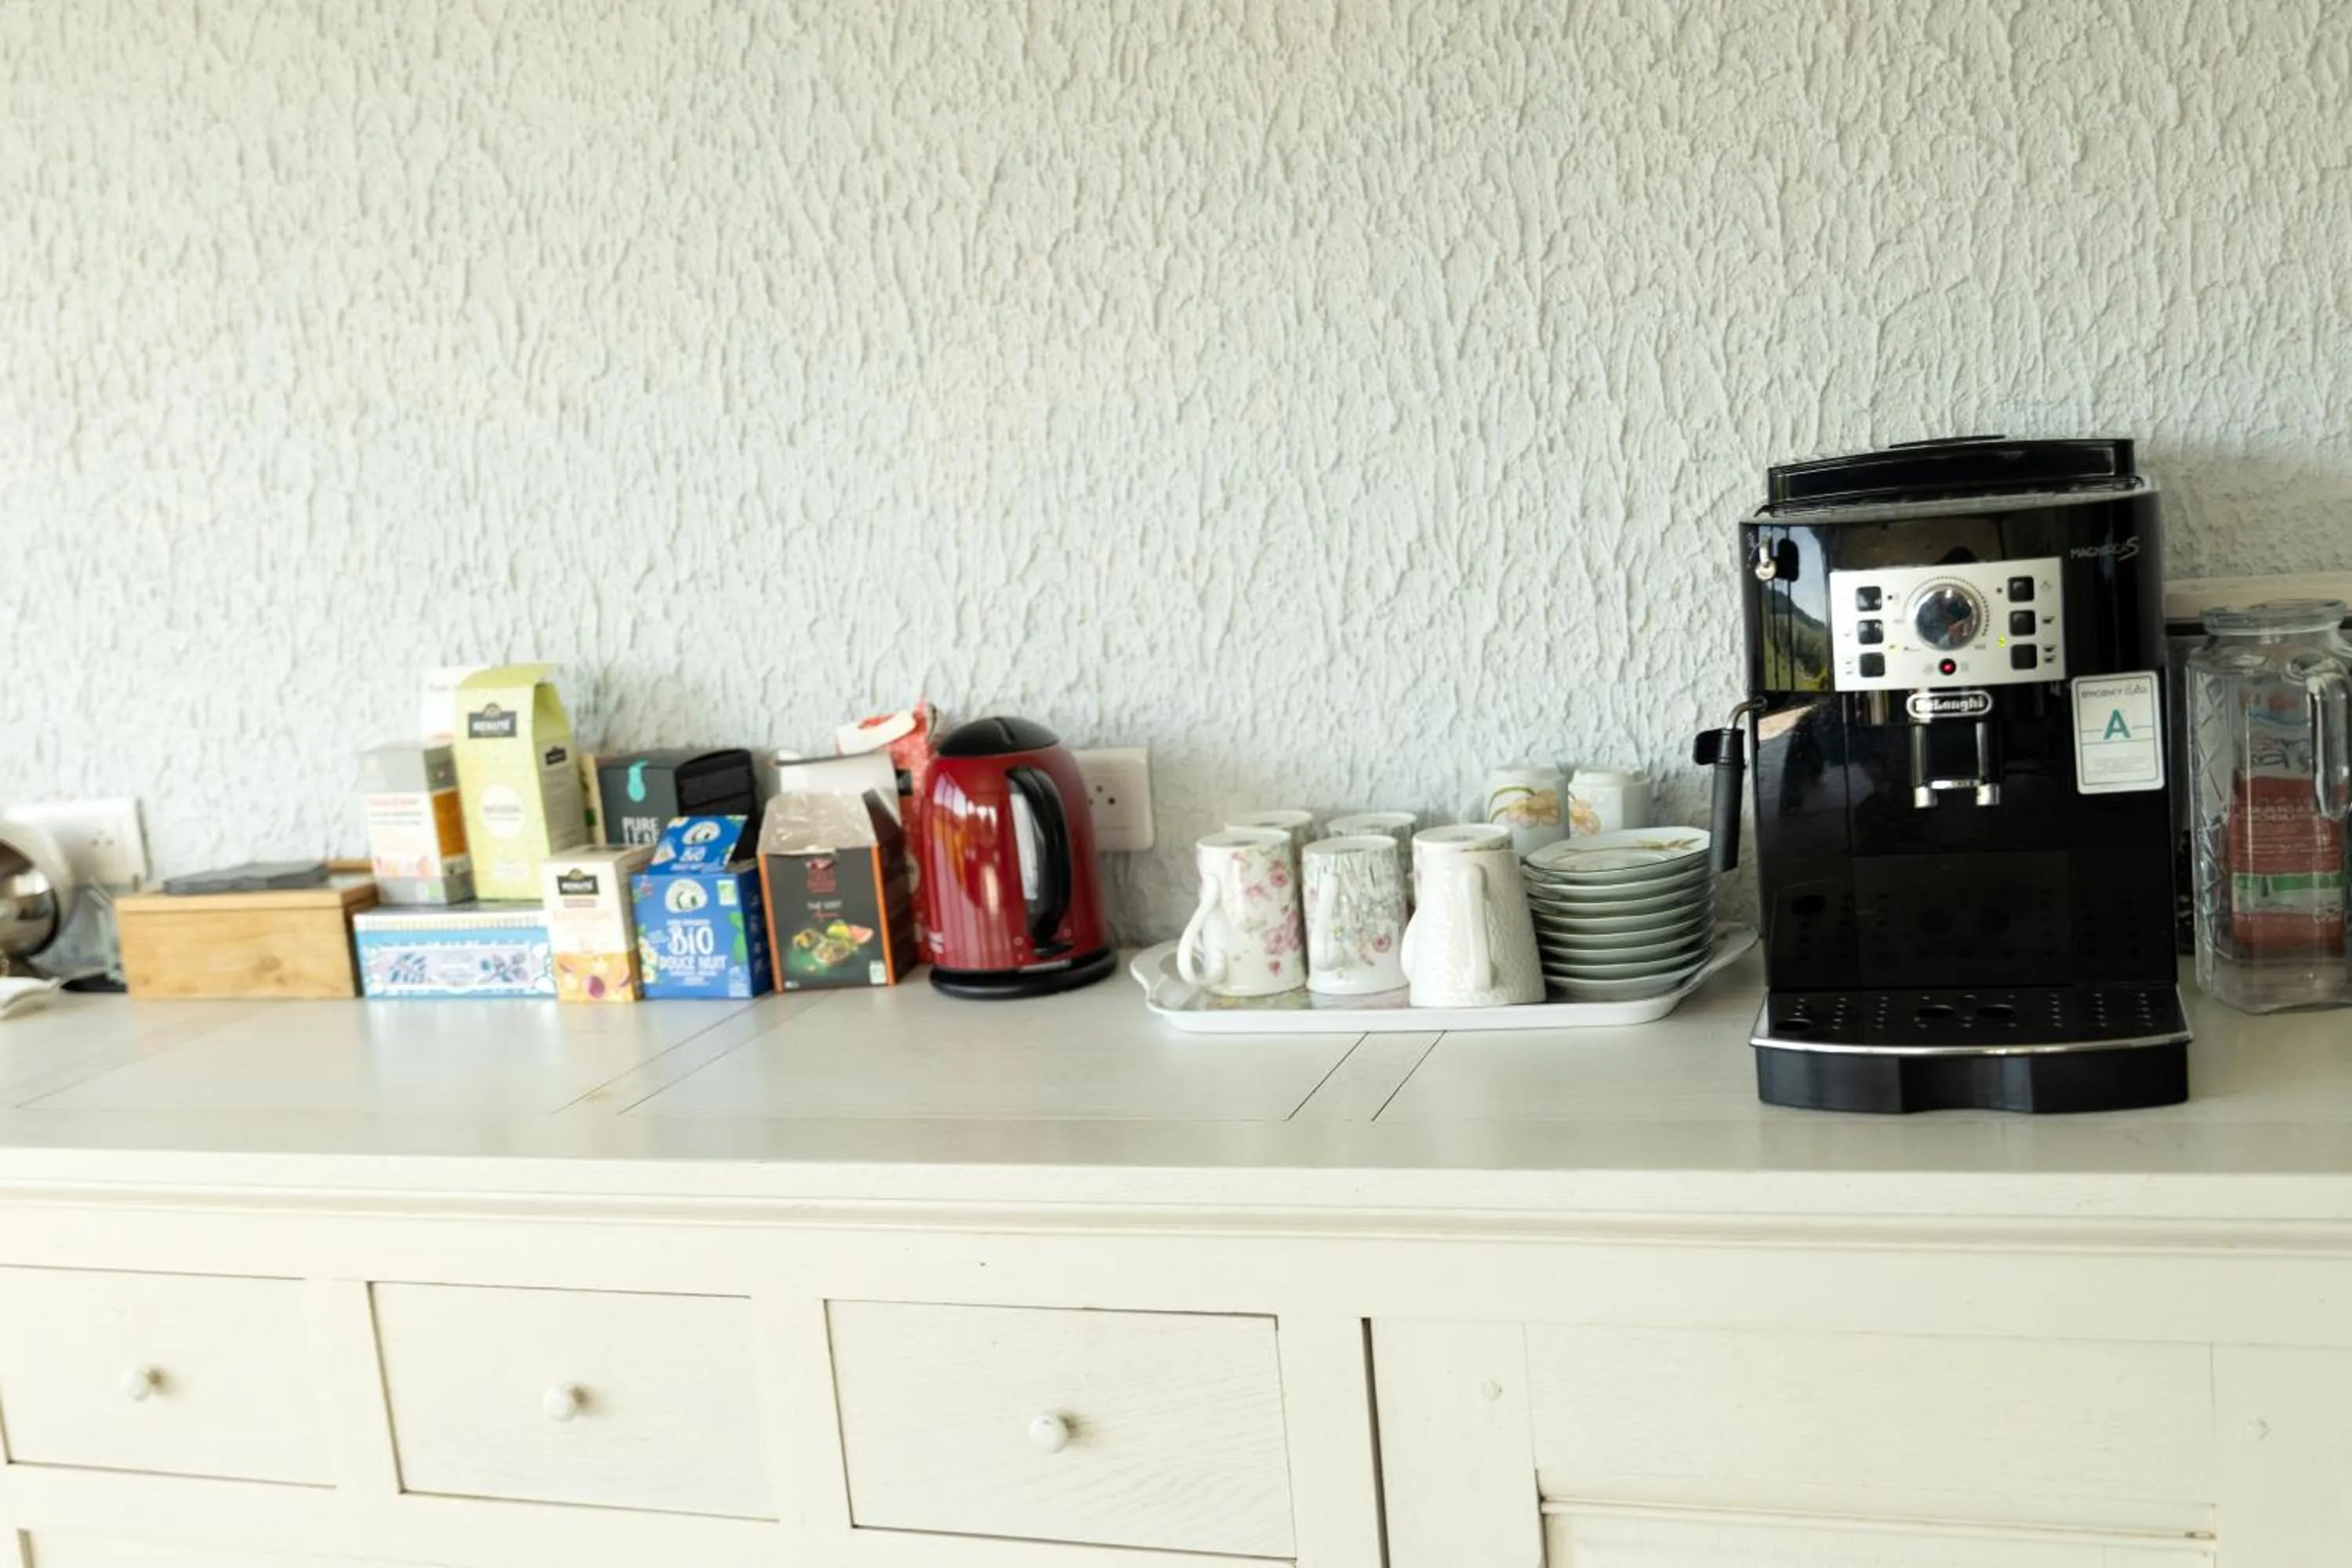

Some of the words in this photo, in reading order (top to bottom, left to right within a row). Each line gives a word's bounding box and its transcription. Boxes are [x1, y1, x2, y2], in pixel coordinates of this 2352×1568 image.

[1915, 695, 1984, 713] Longhi
[2103, 709, 2131, 740] A
[622, 816, 659, 831] PURE
